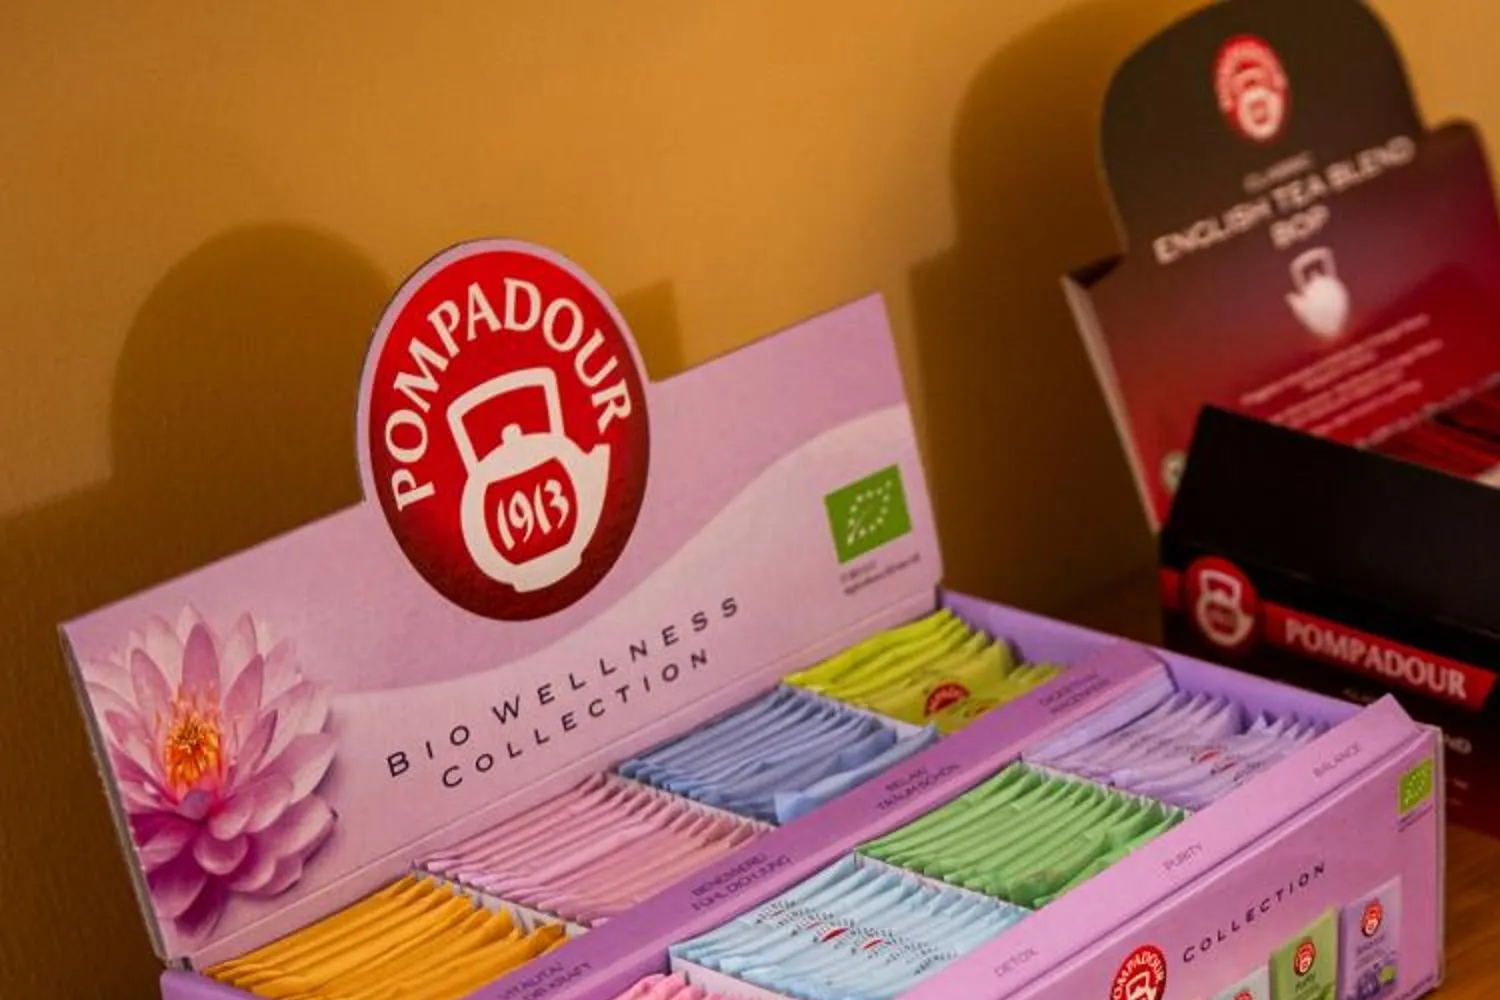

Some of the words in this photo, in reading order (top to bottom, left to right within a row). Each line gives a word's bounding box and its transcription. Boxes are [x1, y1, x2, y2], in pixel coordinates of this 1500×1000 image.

[1152, 198, 1273, 265] ENGLISH
[1271, 173, 1329, 214] TEA
[1325, 135, 1416, 193] BLEND
[386, 277, 632, 511] POMPADOUR
[496, 477, 572, 553] 1913
[386, 724, 470, 778] BIO
[492, 597, 739, 725] WELLNESS
[441, 649, 708, 788] COLLECTION
[1283, 617, 1467, 700] POMPADOUR
[1182, 862, 1327, 964] COLLECTION
